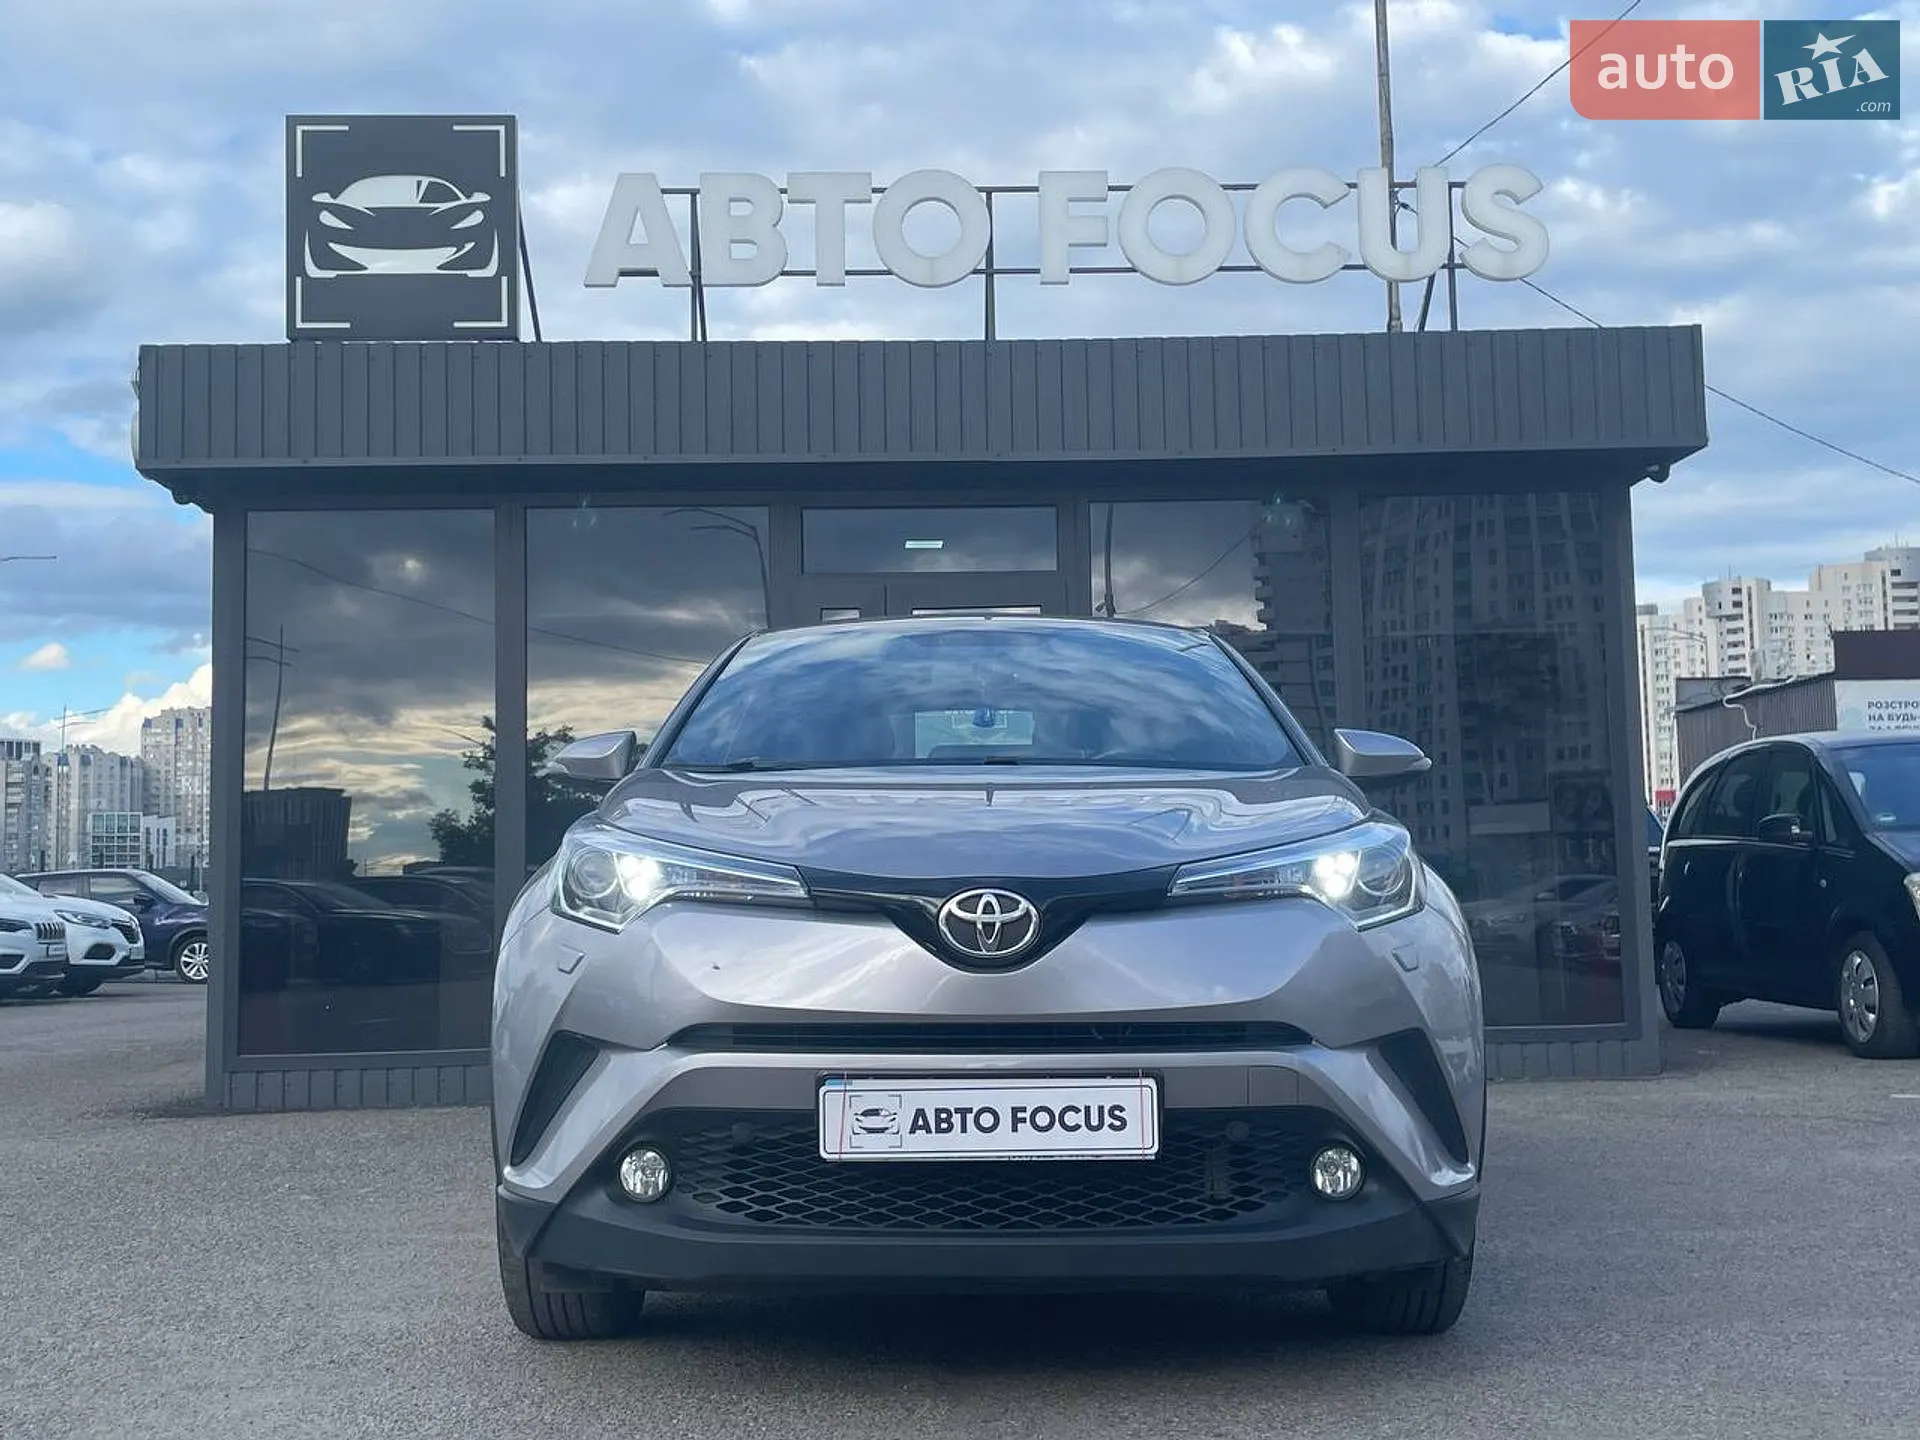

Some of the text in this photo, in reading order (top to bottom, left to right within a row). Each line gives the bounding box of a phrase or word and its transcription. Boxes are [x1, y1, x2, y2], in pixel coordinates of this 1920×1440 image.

[583, 163, 1550, 288] АВТО FOCUS
[1868, 713, 1884, 721] НА
[908, 1104, 1128, 1134] АВТО FOCUS
